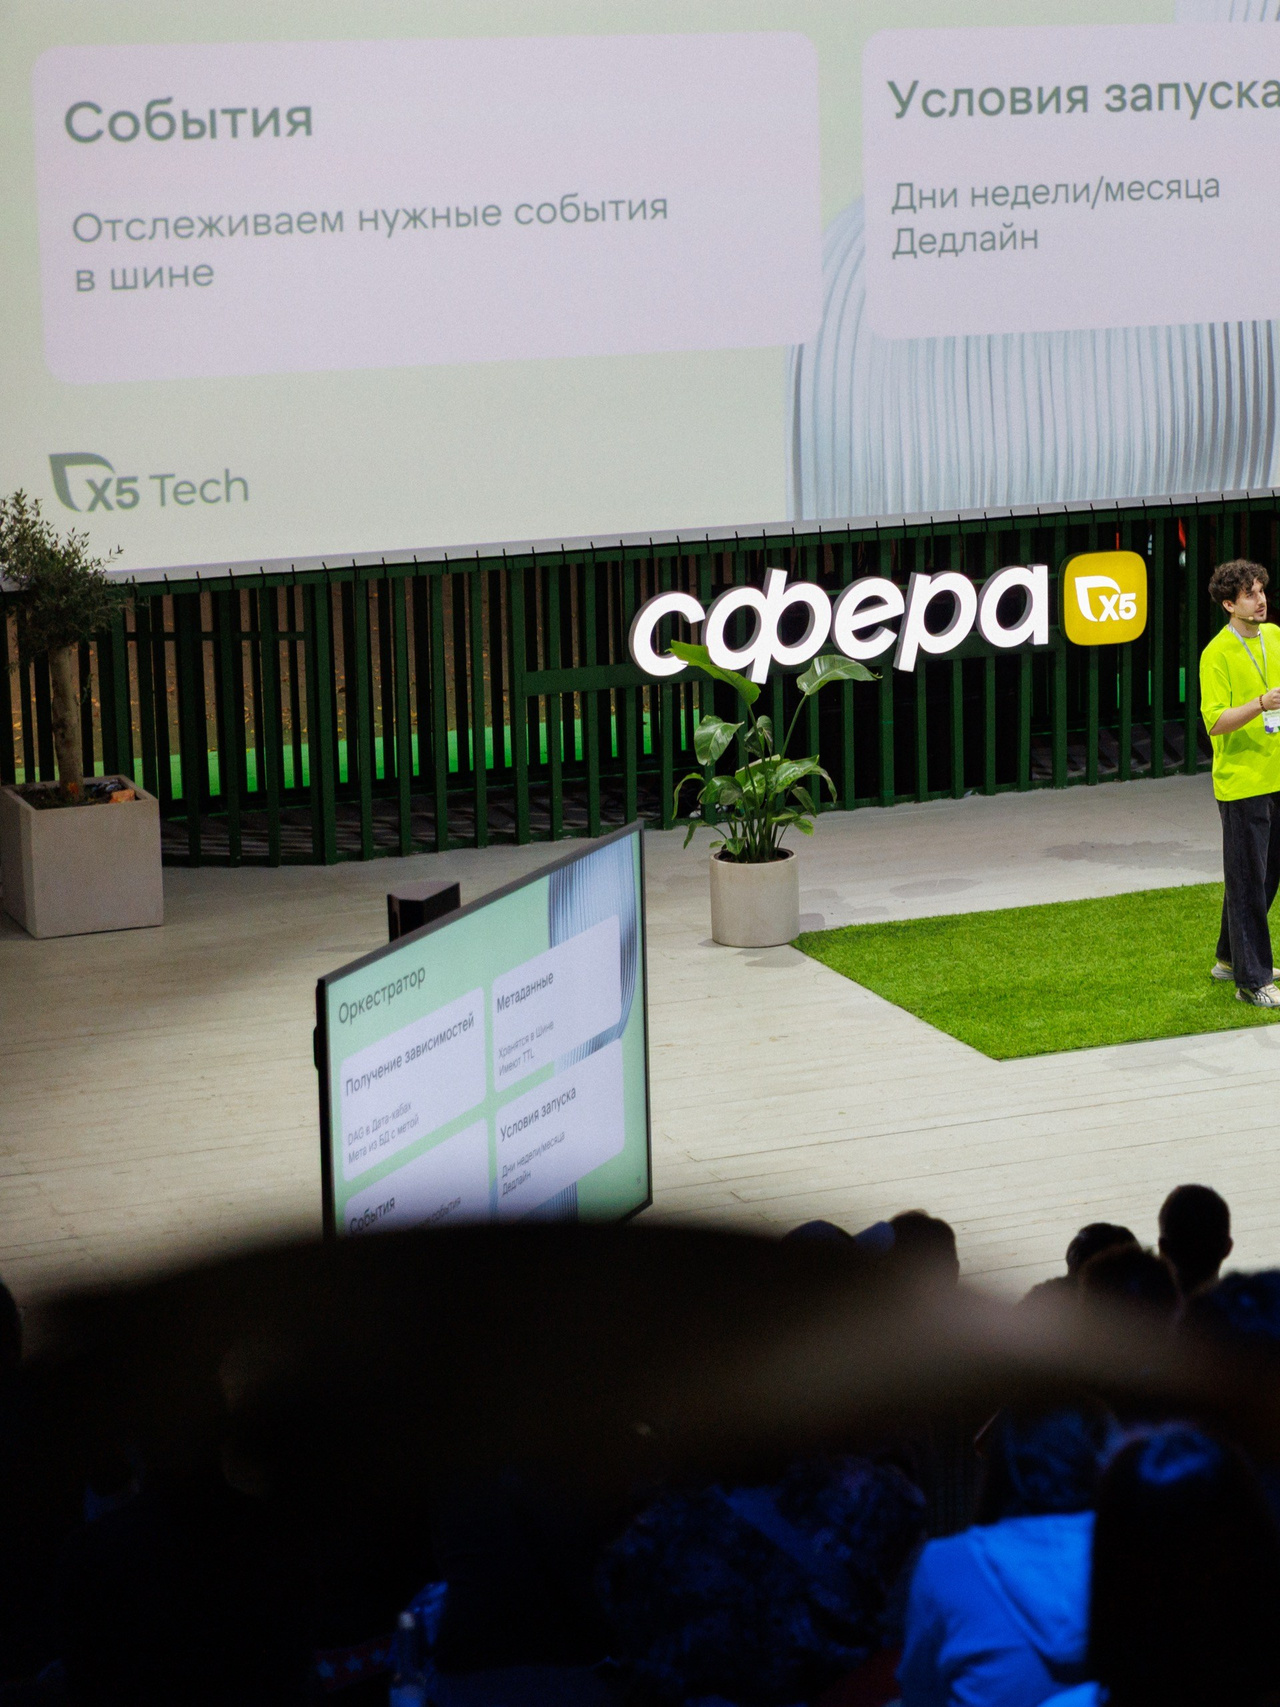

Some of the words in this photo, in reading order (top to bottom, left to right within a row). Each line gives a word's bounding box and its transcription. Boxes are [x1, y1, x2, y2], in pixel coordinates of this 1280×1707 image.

[64, 97, 313, 143] События
[888, 79, 1089, 120] Условия
[892, 181, 959, 215] Дни
[971, 174, 1221, 210] недели/месяца
[72, 210, 345, 243] Отслеживаем
[358, 199, 503, 237] нужные
[514, 192, 669, 225] события
[892, 223, 1039, 259] Дедлайн
[75, 266, 96, 292] в
[110, 260, 215, 291] шине
[86, 476, 140, 512] X5
[150, 469, 249, 508] Tech
[629, 564, 1049, 684] сфера
[1099, 592, 1137, 622] X5
[338, 967, 426, 1025] Оркестратор
[497, 972, 554, 1013] Метаданные
[345, 1055, 402, 1096] Получение
[405, 1011, 475, 1063] зависимостей
[500, 1109, 539, 1142] Условия
[541, 1087, 577, 1118] запуска
[350, 1197, 395, 1234] События
